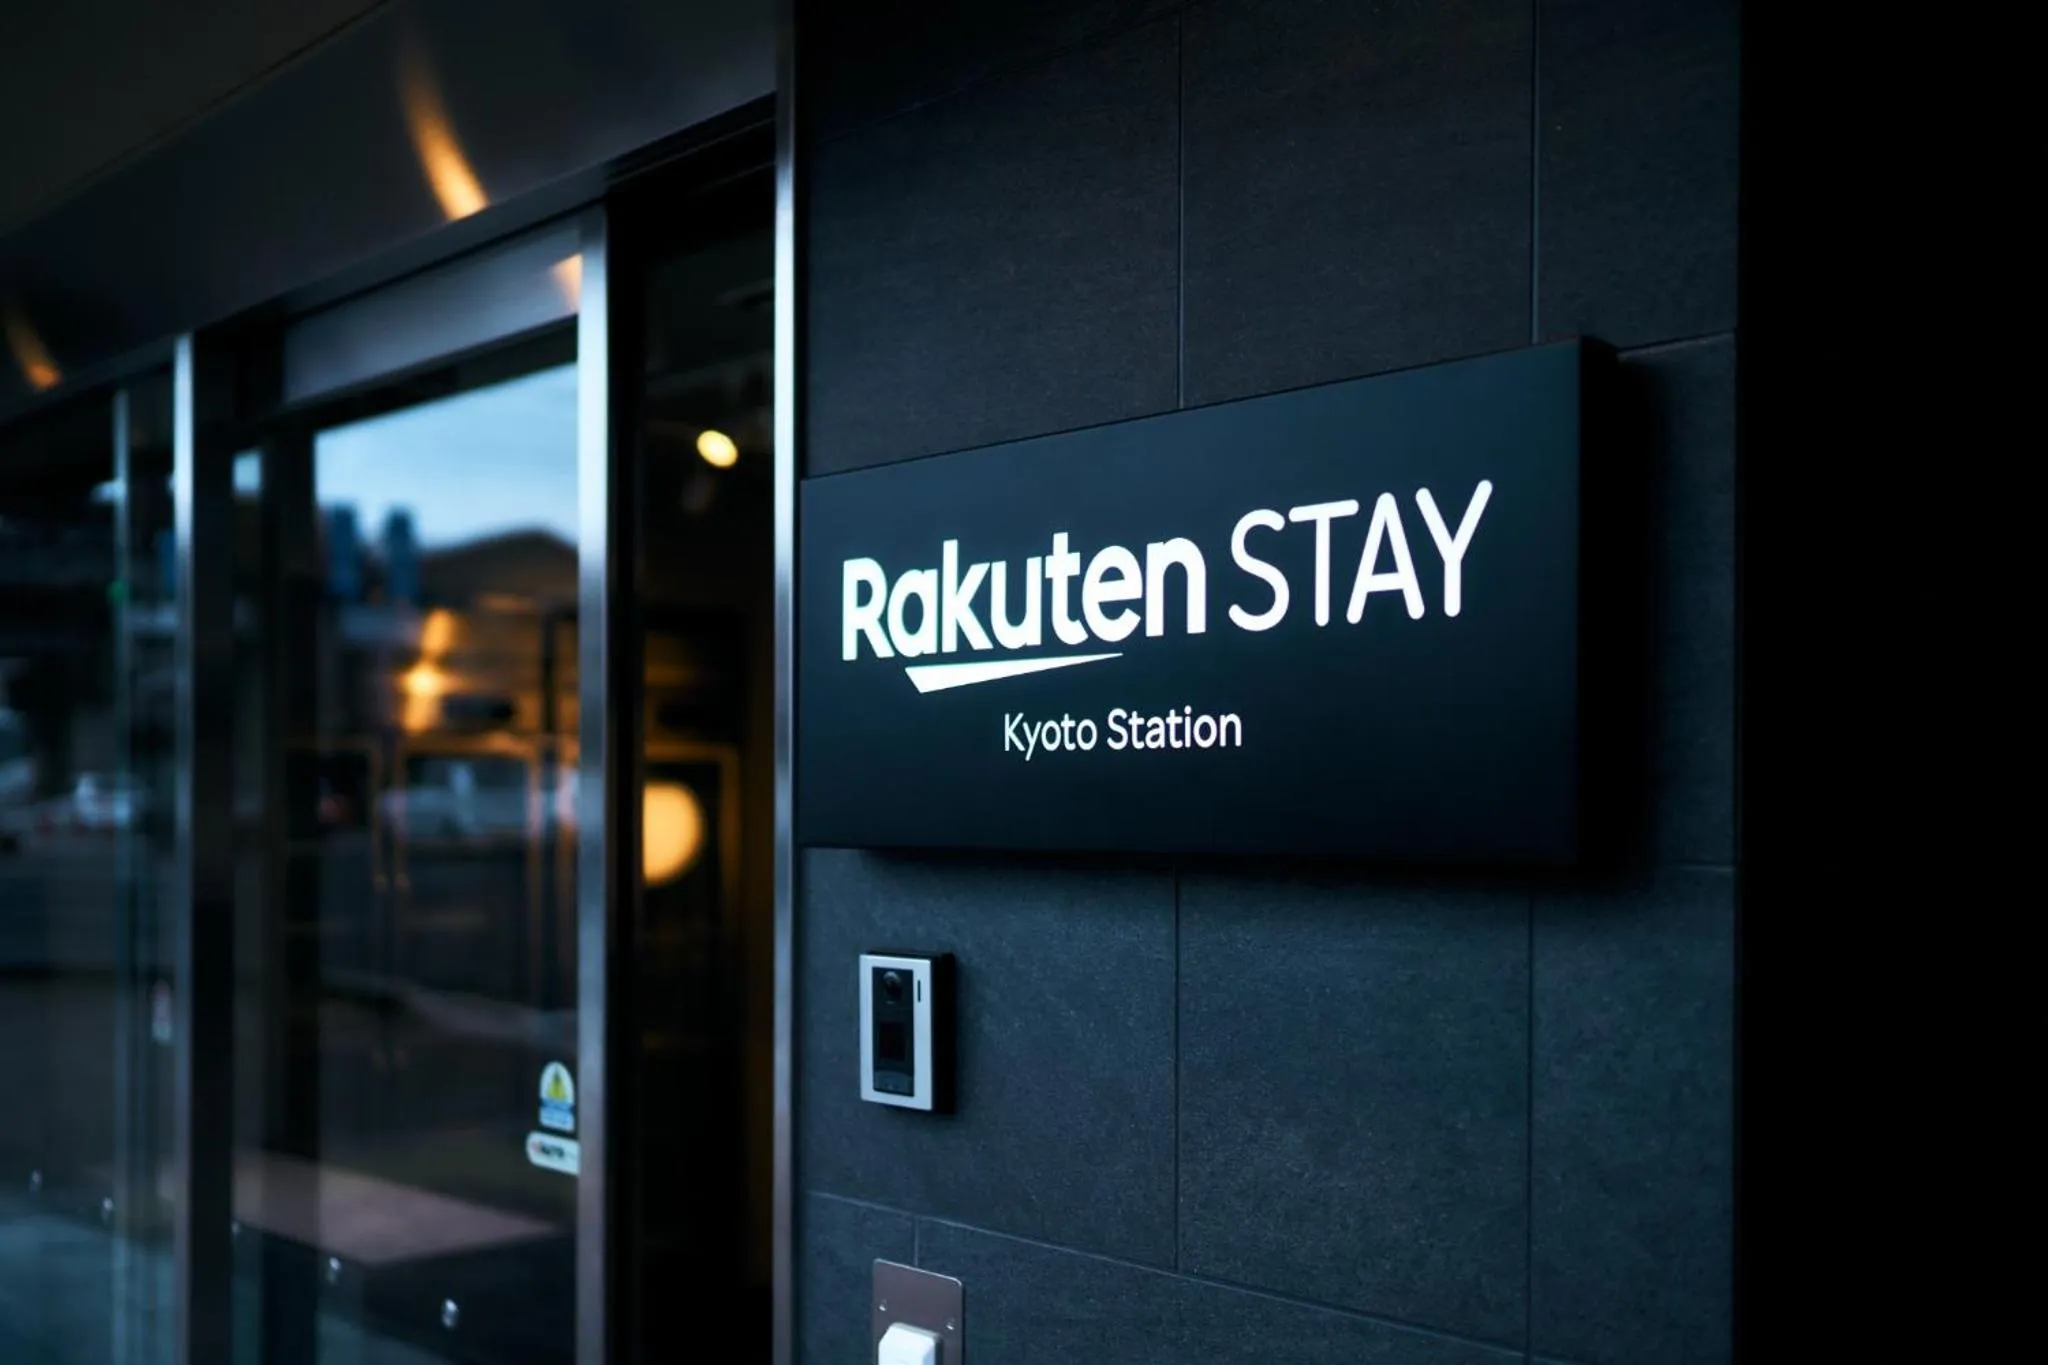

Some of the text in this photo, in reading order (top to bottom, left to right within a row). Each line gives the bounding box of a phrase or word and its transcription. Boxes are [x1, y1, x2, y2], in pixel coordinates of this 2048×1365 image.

[842, 480, 1492, 661] Rakuten STAY
[1004, 705, 1242, 761] Kyoto Station
